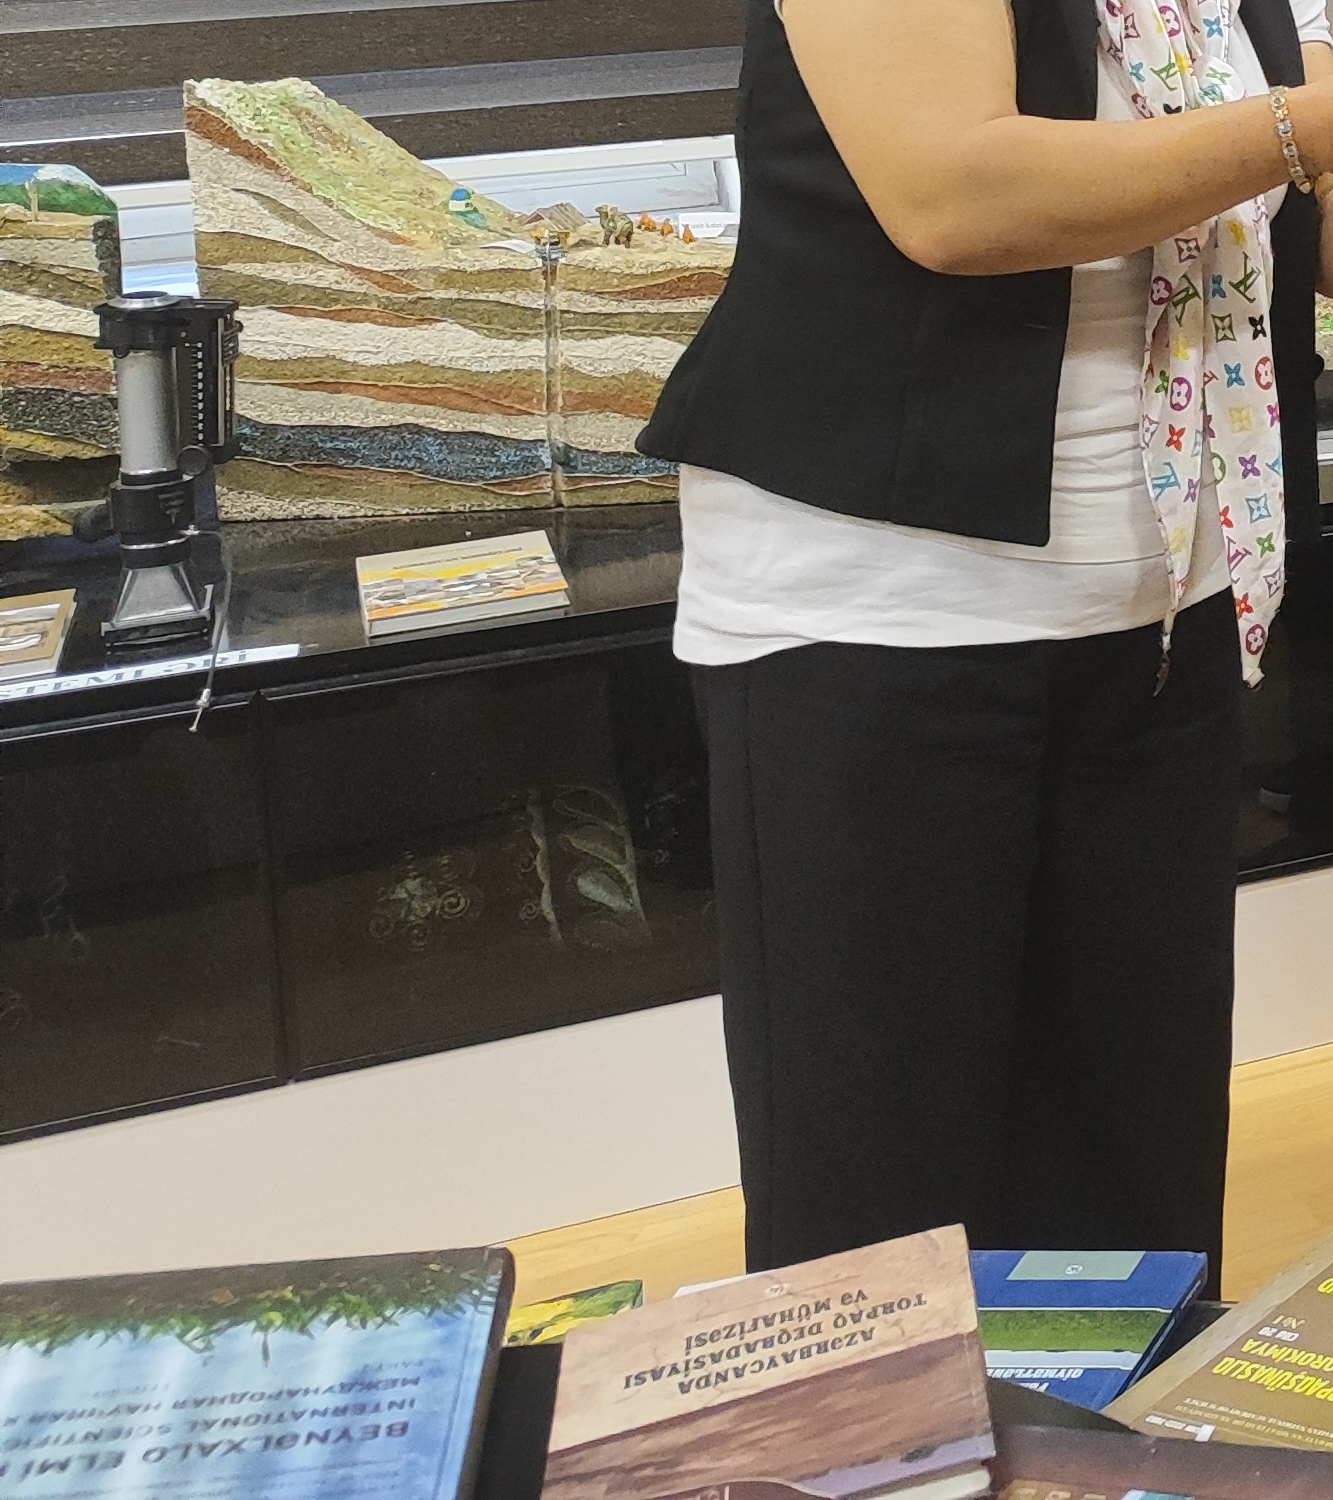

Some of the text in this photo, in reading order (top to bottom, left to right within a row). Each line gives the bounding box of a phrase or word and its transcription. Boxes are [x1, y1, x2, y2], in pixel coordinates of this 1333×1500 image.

[683, 1297, 832, 1357] MÜHAFİZƏSİ
[831, 1292, 928, 1331] TORPAQ
[676, 1327, 875, 1395] AZƏRBAYCANDA
[189, 1397, 417, 1433] INTERNATIONAL
